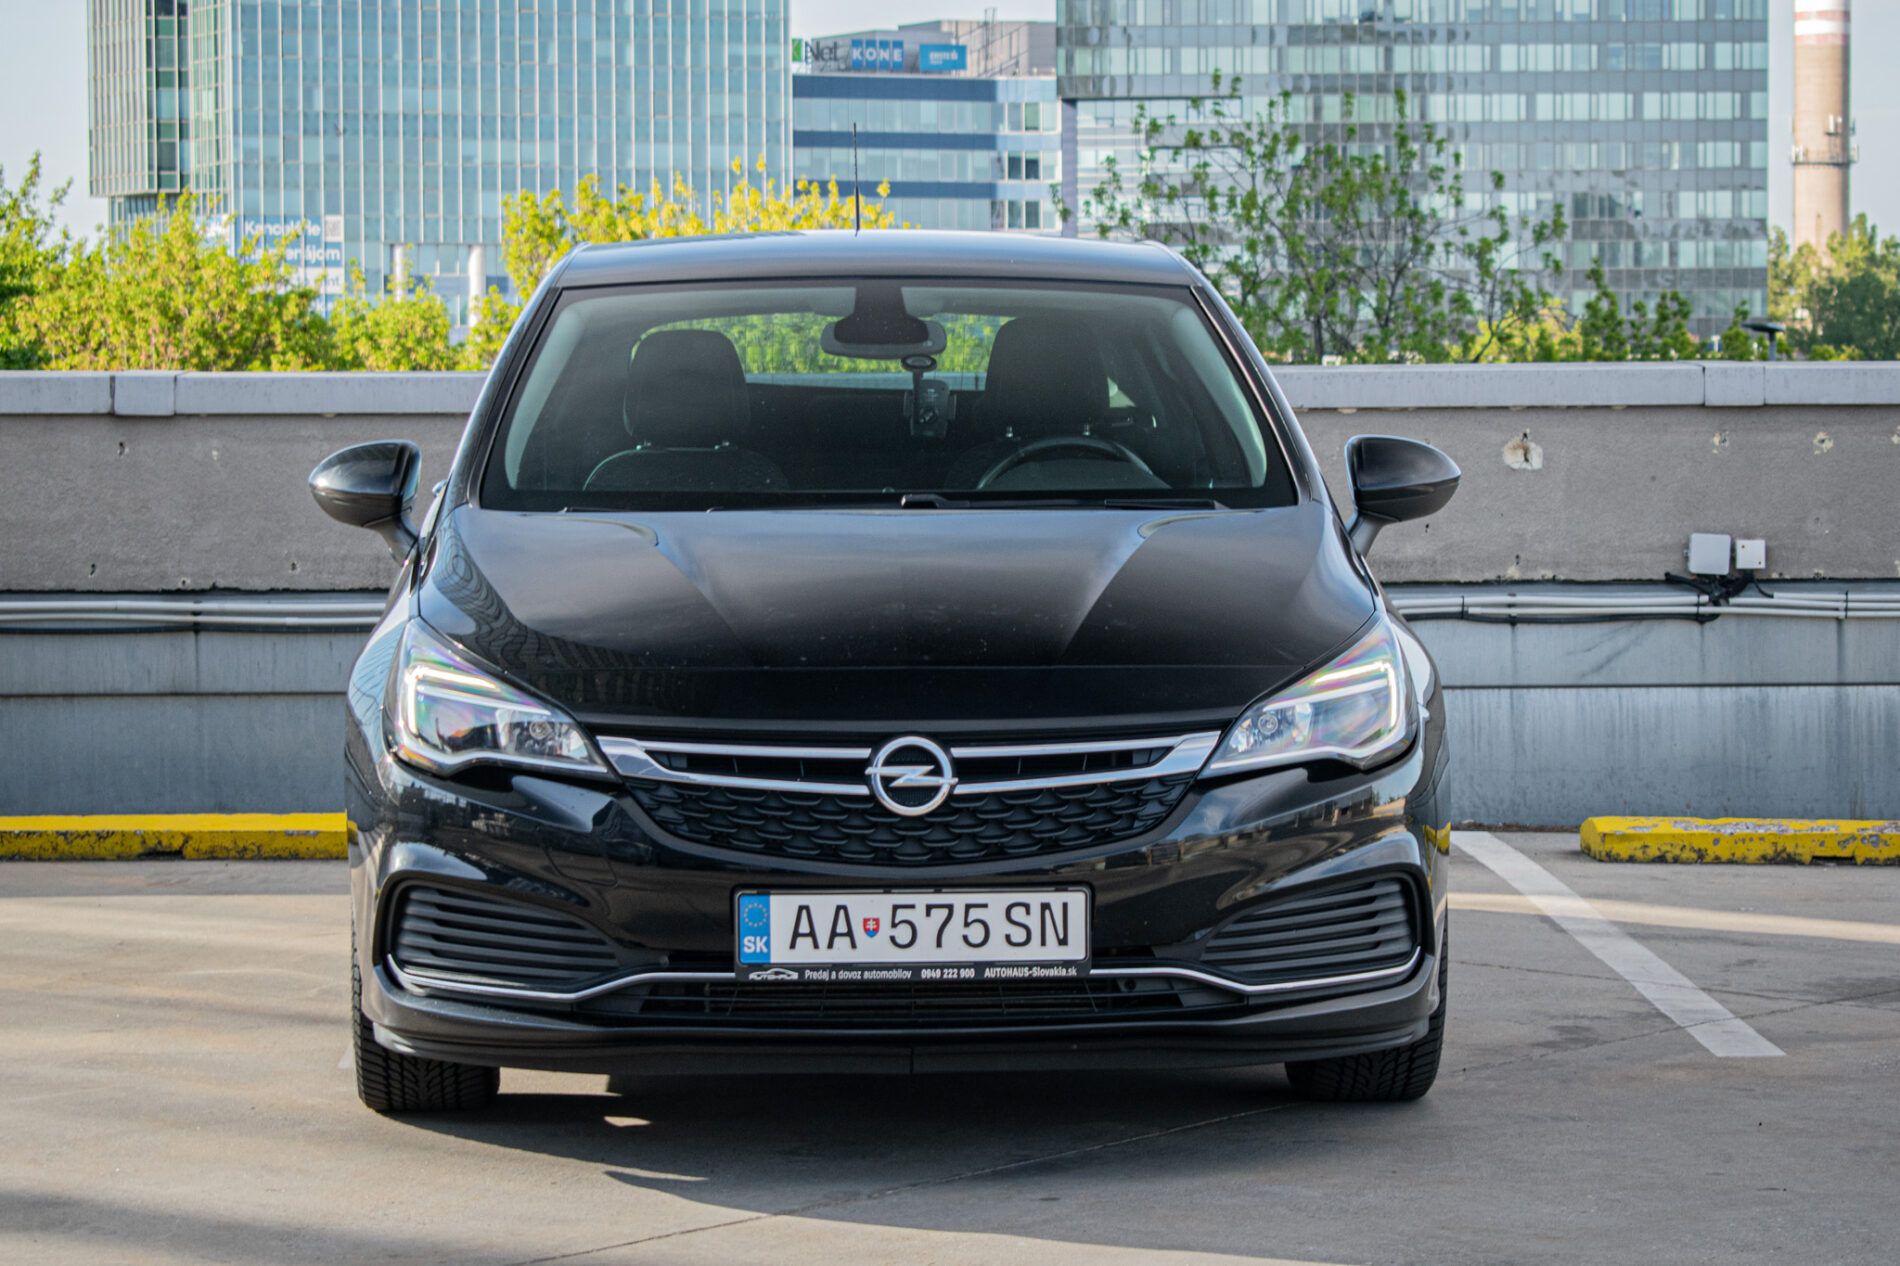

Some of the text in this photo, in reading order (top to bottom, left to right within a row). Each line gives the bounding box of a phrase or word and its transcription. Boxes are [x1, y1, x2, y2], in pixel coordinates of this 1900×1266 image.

[852, 47, 903, 62] KONE
[789, 904, 857, 950] AA
[743, 936, 768, 953] SK
[804, 969, 829, 981] Predaj
[831, 970, 837, 979] a
[838, 969, 862, 980] dovoz
[863, 968, 912, 980] automobilov
[943, 968, 958, 979] 222
[984, 966, 1078, 979] AUTOHAUS-Slovakia.sk
